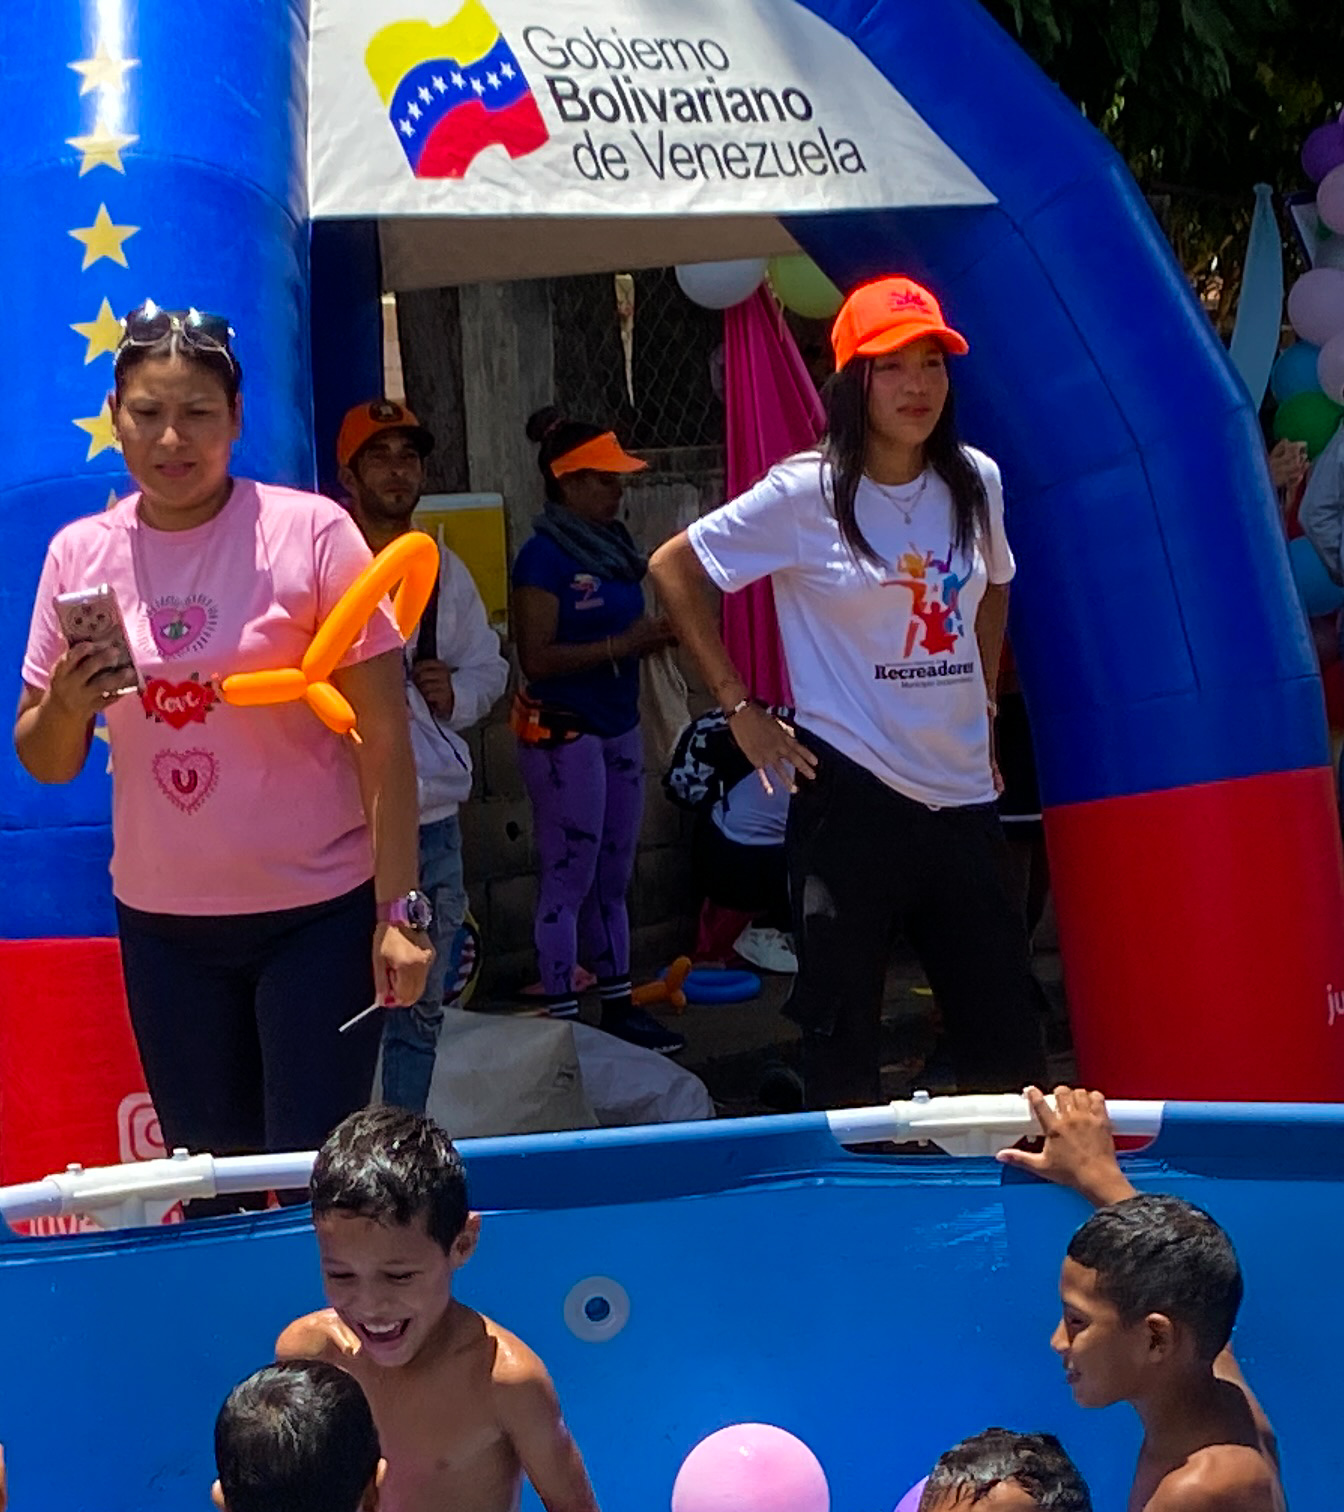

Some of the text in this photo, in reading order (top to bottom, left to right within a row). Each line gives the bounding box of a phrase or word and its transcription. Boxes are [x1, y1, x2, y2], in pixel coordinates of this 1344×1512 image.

[522, 25, 730, 71] Gobierno
[545, 75, 814, 124] Bolivariano
[572, 126, 868, 181] de Venezuela
[171, 769, 198, 794] U
